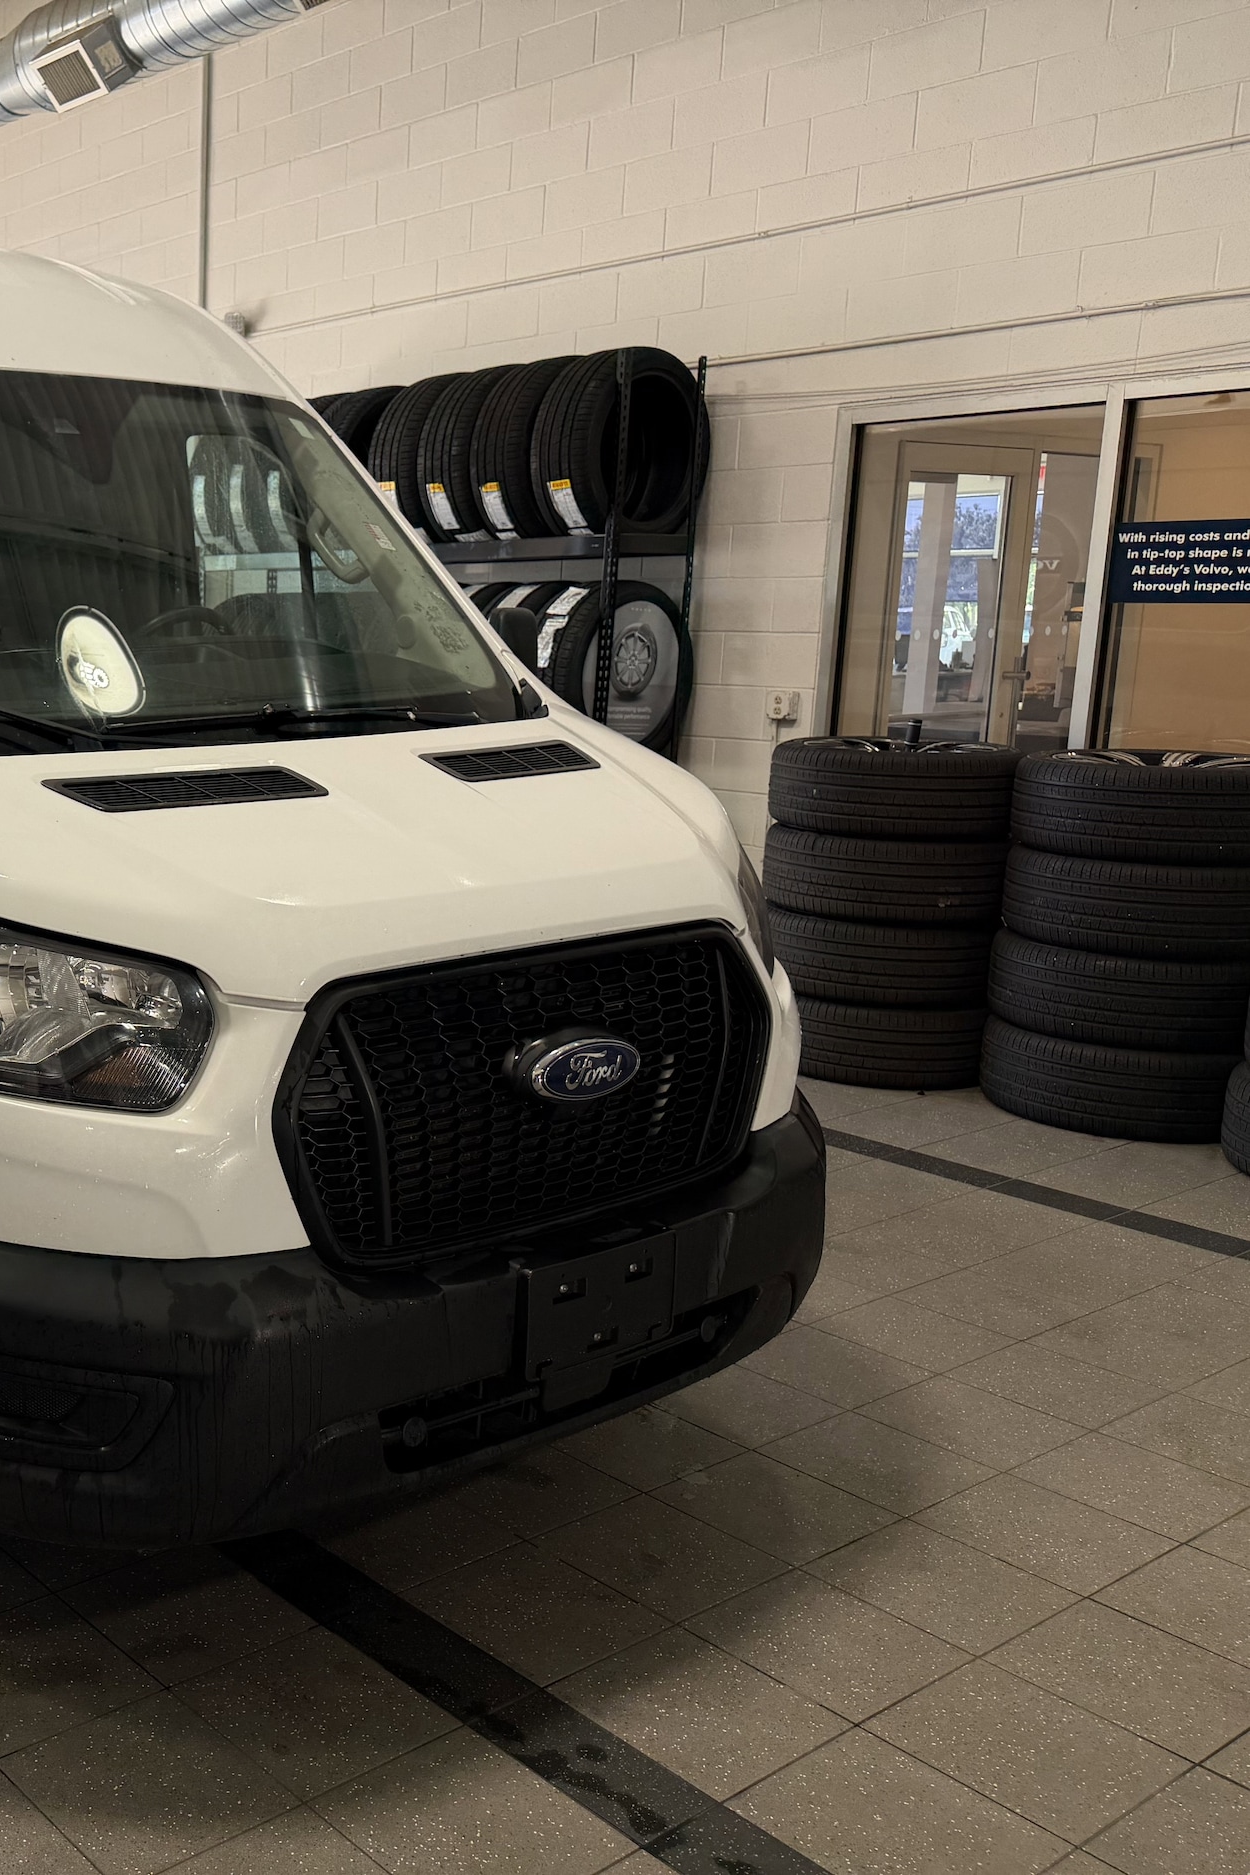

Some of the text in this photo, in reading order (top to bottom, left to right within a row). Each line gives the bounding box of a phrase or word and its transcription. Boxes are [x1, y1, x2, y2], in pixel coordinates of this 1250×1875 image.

[1118, 529, 1250, 544] With rising costs and
[1127, 549, 1139, 559] in
[1142, 548, 1185, 561] tip-top
[1188, 547, 1229, 560] shape
[1232, 546, 1243, 557] is
[1131, 565, 1146, 575] At
[1149, 564, 1190, 577] Eddy's
[1193, 563, 1233, 576] Volvo,
[1132, 580, 1190, 593] thorough
[565, 1050, 623, 1091] Ford
